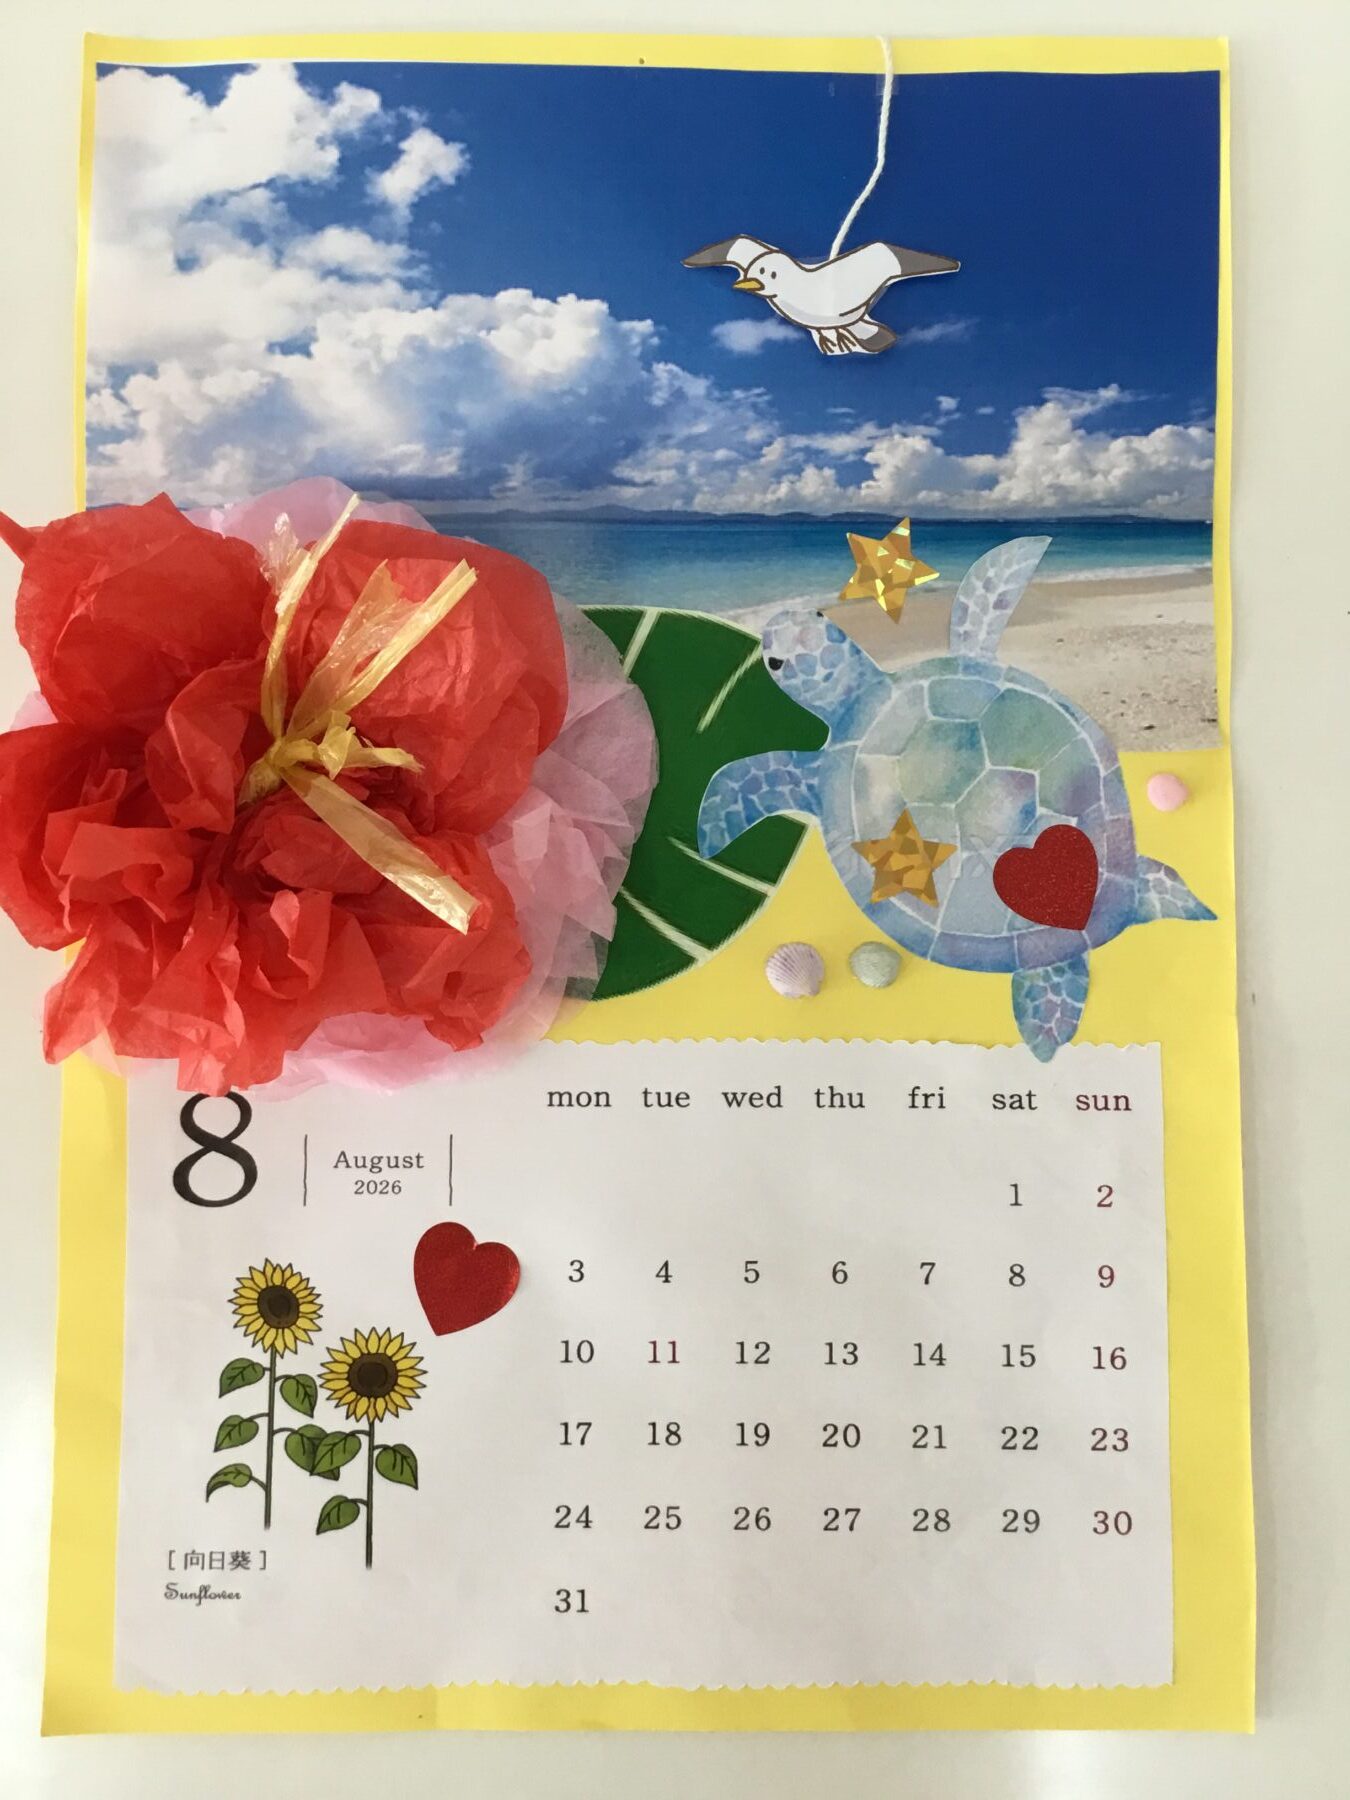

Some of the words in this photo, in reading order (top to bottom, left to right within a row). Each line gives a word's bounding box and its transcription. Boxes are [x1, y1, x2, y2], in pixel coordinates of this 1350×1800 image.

[547, 1091, 612, 1107] mon
[642, 1088, 690, 1108] tue
[721, 1085, 783, 1109] wed
[814, 1086, 865, 1109] thu
[908, 1086, 947, 1109] fri
[992, 1090, 1038, 1110] sat
[1076, 1095, 1132, 1112] sun
[173, 1091, 258, 1208] 8
[333, 1150, 425, 1174] August
[353, 1179, 402, 1196] 2026
[1009, 1183, 1023, 1207] 1
[1096, 1184, 1114, 1208] 2
[567, 1259, 585, 1284] 3
[655, 1260, 673, 1284] 4
[744, 1260, 760, 1285] 5
[832, 1261, 848, 1285] 6
[919, 1262, 936, 1286] 7
[1009, 1263, 1026, 1288] 8
[1098, 1265, 1115, 1289] 9
[560, 1340, 595, 1364] 10
[647, 1340, 681, 1364] 11
[735, 1341, 771, 1365] 12
[824, 1342, 859, 1366] 13
[913, 1343, 947, 1367] 14
[1002, 1344, 1036, 1368] 15
[1093, 1346, 1127, 1370] 16
[559, 1422, 592, 1446] 17
[648, 1422, 682, 1447] 18
[736, 1422, 771, 1447] 19
[822, 1423, 861, 1448] 20
[912, 1425, 948, 1450] 21
[1001, 1426, 1039, 1451] 22
[1091, 1427, 1129, 1452] 23
[554, 1504, 593, 1530] 24
[644, 1505, 682, 1531] 25
[733, 1506, 772, 1532] 26
[823, 1508, 861, 1533] 27
[913, 1508, 951, 1533] 28
[1002, 1509, 1041, 1534] 29
[1093, 1511, 1133, 1536] 30
[164, 1582, 241, 1606] Sunflower
[554, 1588, 589, 1613] 31
